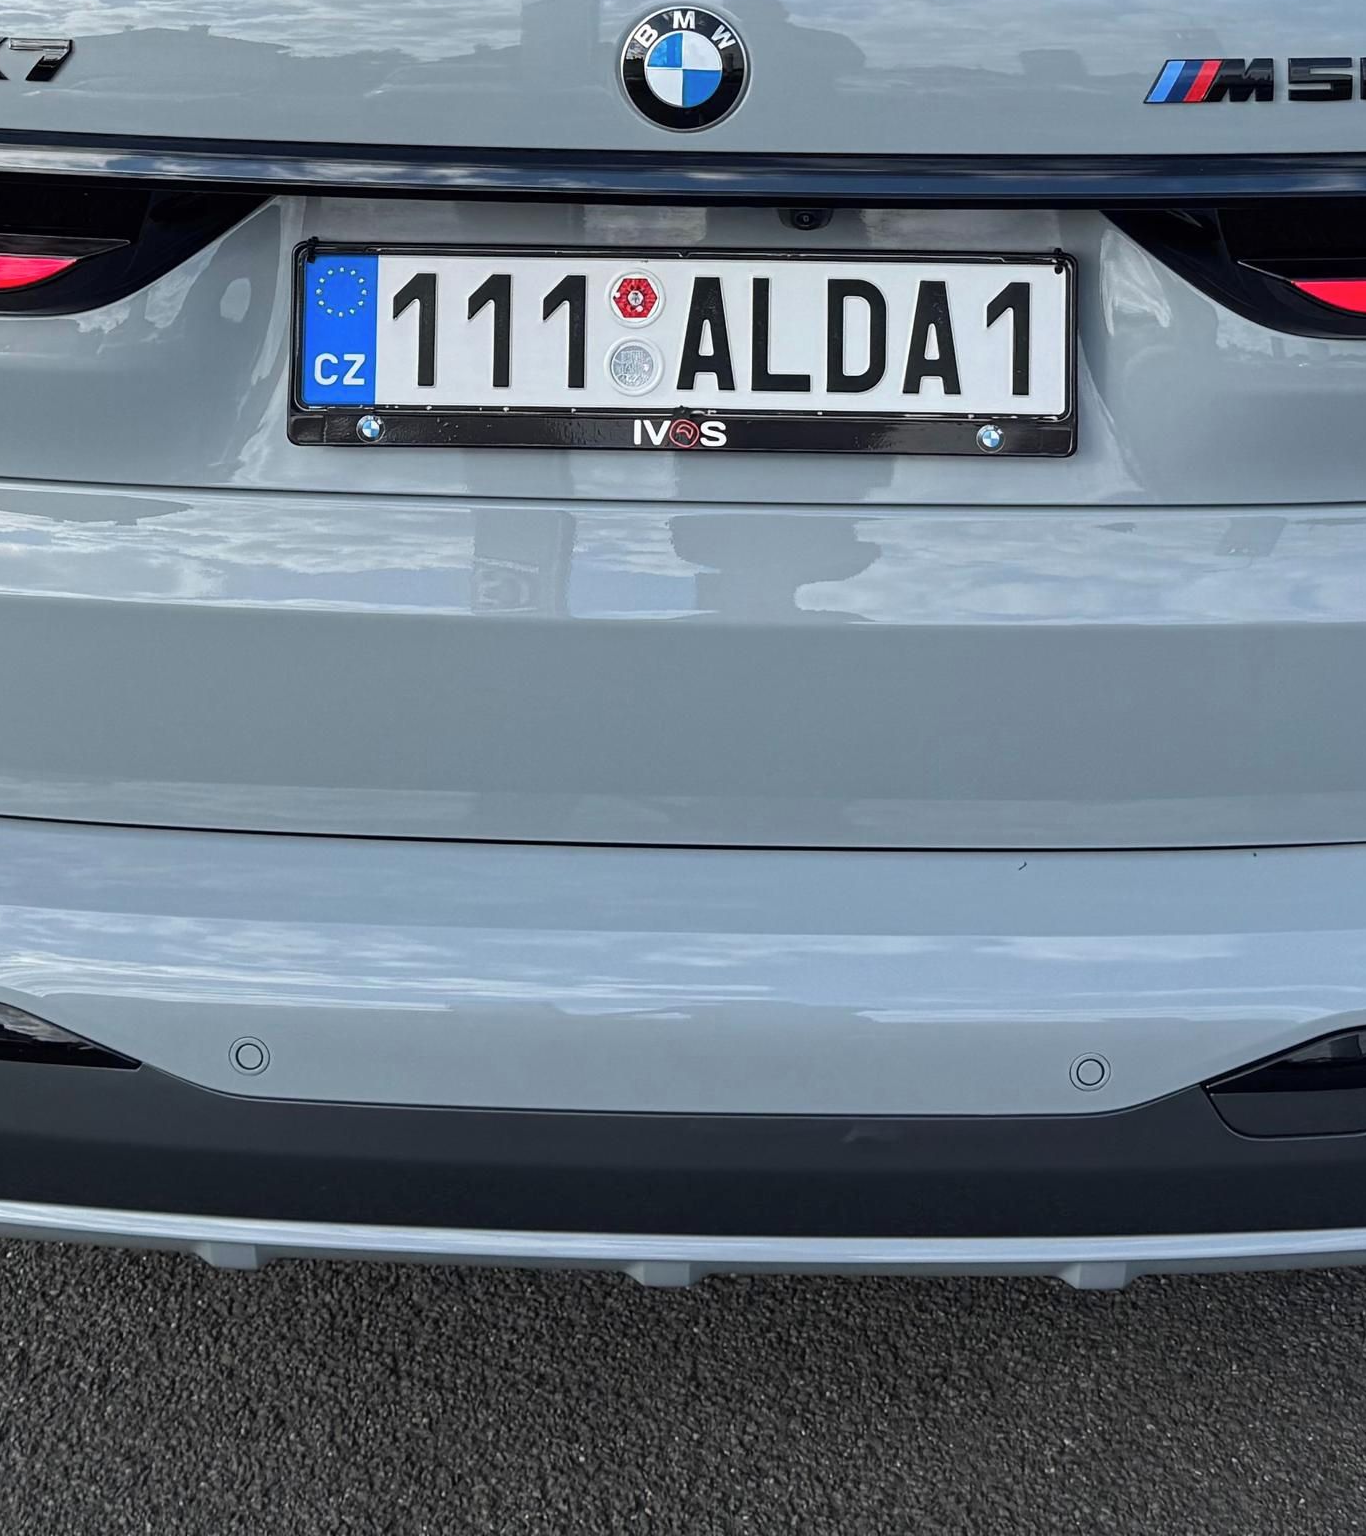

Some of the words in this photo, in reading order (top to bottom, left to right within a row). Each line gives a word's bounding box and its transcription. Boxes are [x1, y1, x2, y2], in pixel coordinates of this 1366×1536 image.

[634, 10, 736, 50] BMW
[392, 272, 587, 388] 111
[676, 276, 1031, 396] ALDA1
[313, 352, 366, 386] CZ
